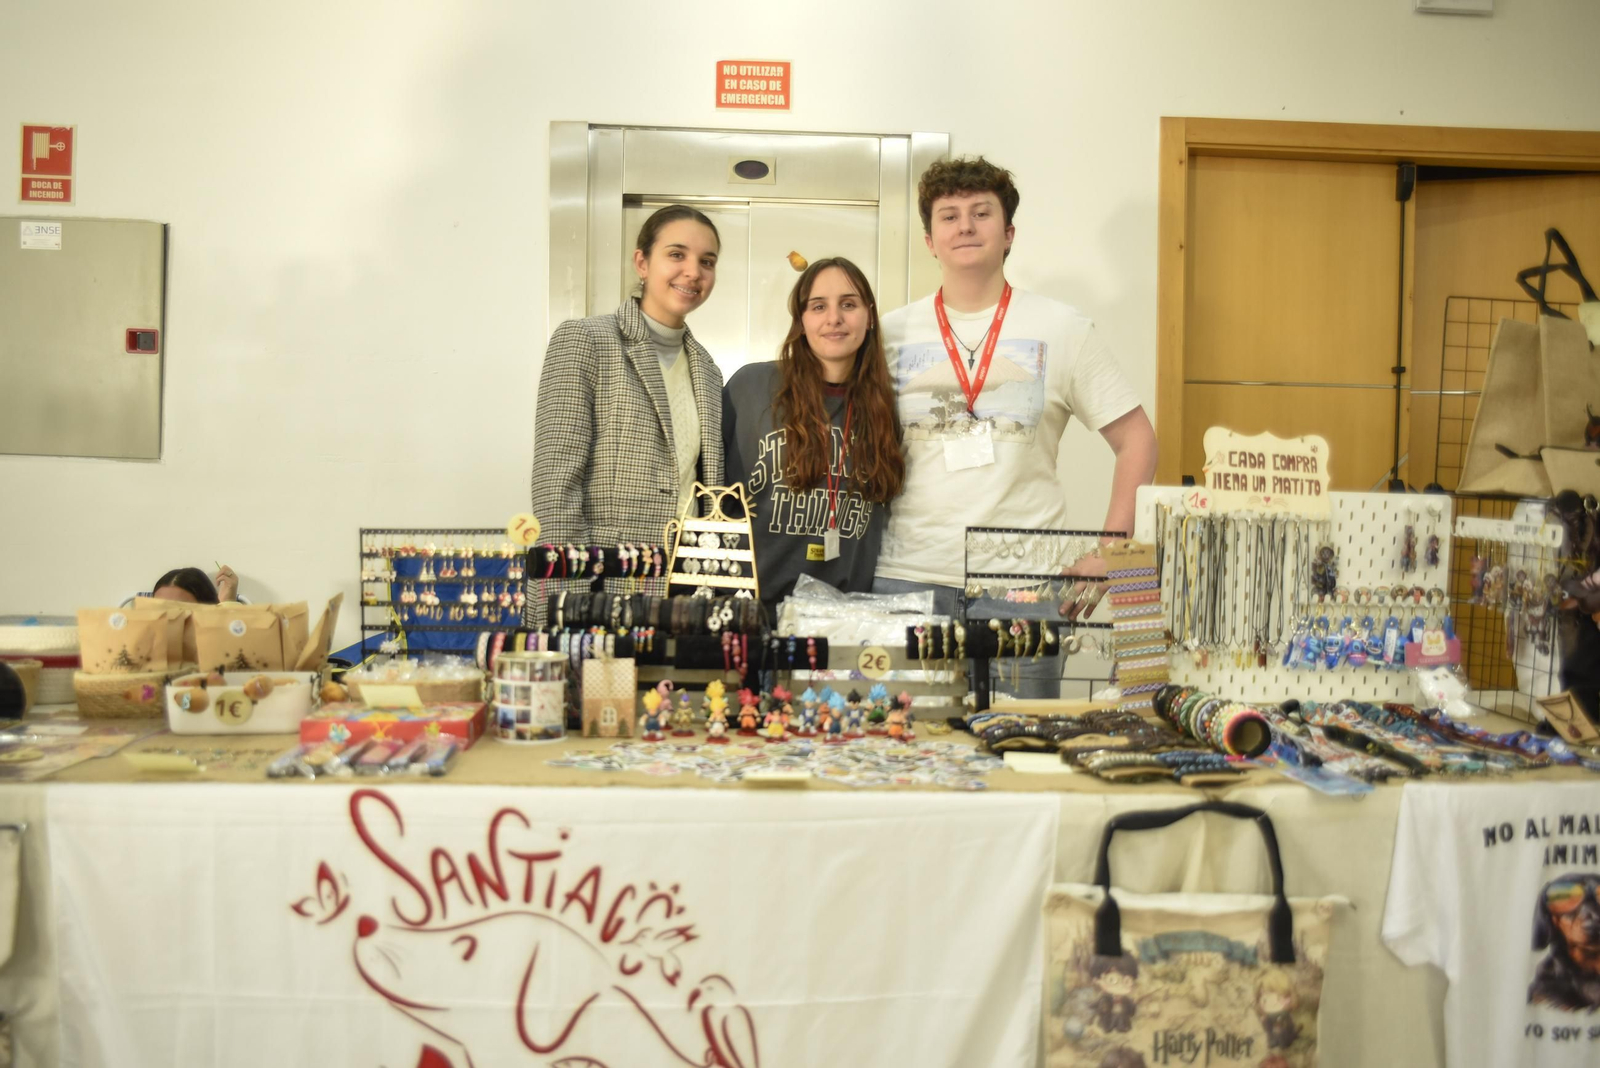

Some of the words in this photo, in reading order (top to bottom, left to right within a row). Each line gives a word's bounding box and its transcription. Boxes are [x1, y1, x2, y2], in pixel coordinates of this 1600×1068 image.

[723, 64, 738, 76] NO
[739, 65, 784, 77] UTILIZAR
[724, 78, 738, 90] EN
[739, 79, 767, 91] CASO
[768, 80, 782, 91] DE
[720, 92, 786, 106] EMERGENCIA
[31, 180, 52, 189] BOCA
[52, 181, 63, 190] DE
[29, 190, 65, 199] INCENDIO
[1228, 450, 1266, 470] CADA
[1272, 453, 1318, 474] COMPRA
[1252, 475, 1266, 493] UN
[768, 484, 873, 540] THINGS
[862, 653, 887, 671] 2€
[216, 699, 243, 719] 1€
[1482, 822, 1514, 848] NO
[1525, 816, 1551, 840] AL
[1551, 1025, 1582, 1042] SOY
[1152, 1027, 1203, 1066] Harry
[1204, 1025, 1255, 1068] Potter
